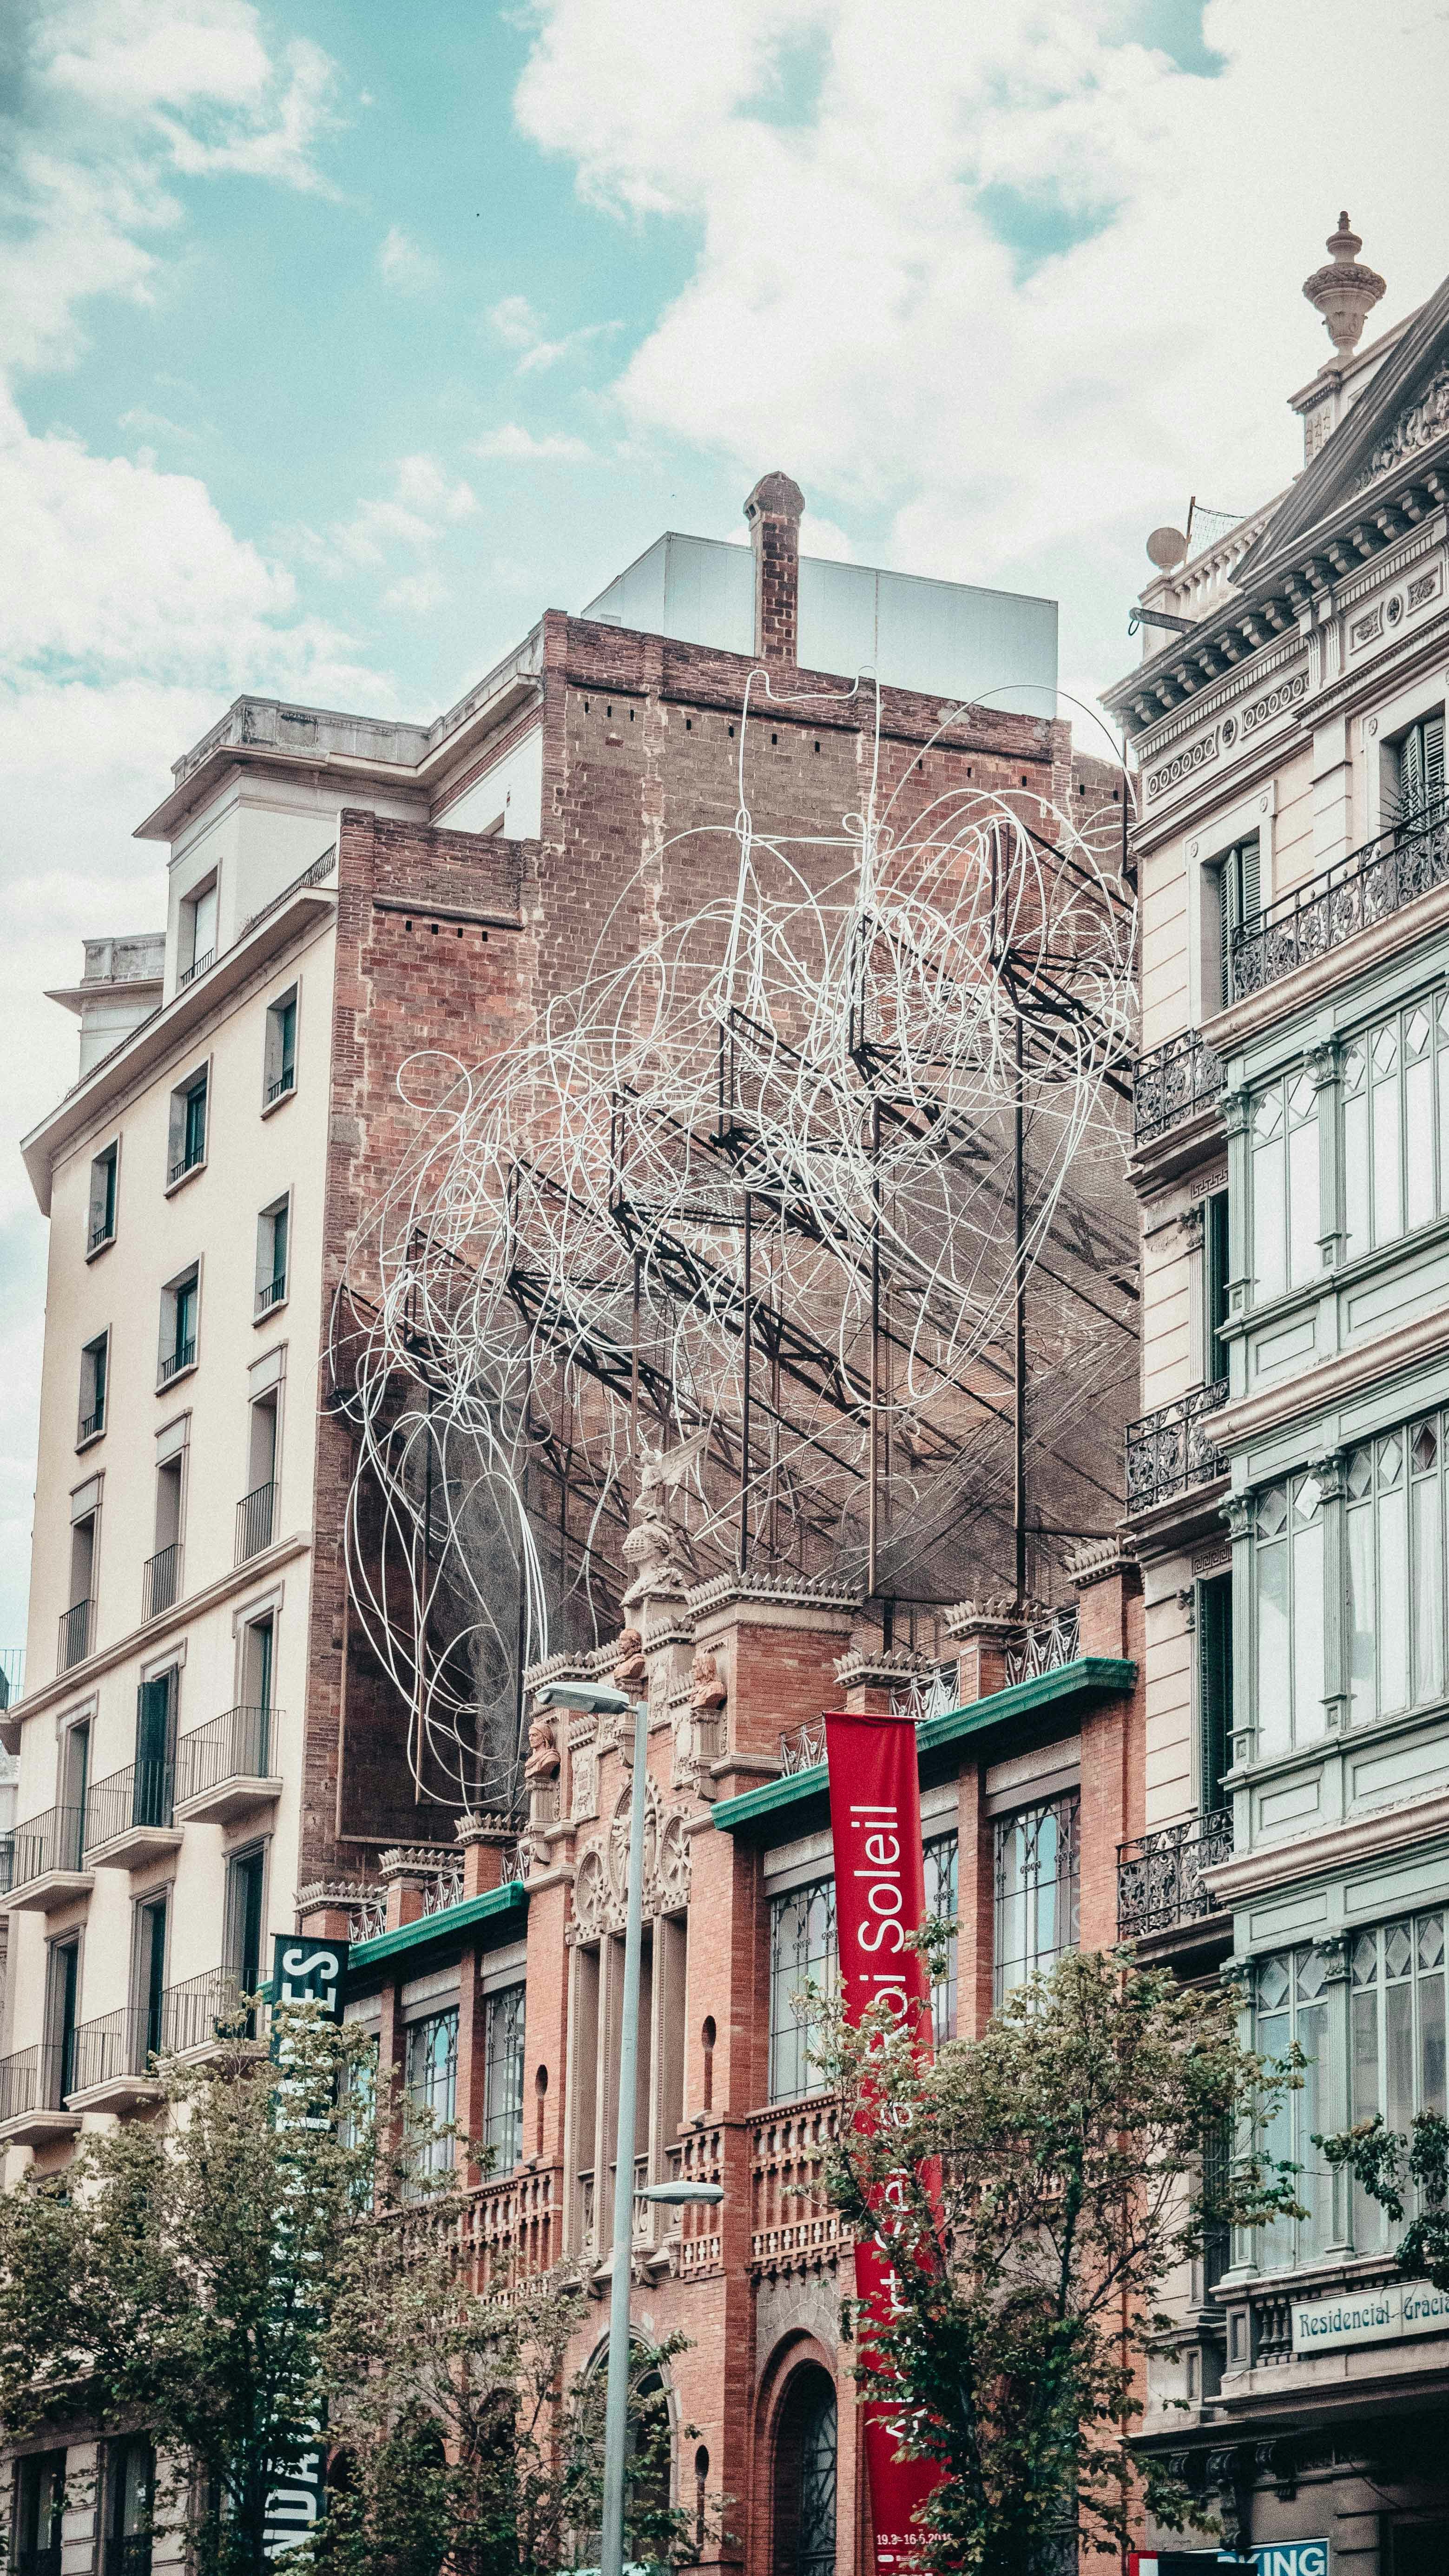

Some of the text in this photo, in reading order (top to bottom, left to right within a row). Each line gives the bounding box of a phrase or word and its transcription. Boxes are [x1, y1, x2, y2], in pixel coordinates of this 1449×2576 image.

[850, 1806, 904, 1953] Soleil
[859, 1975, 909, 2059] Roi
[1299, 2300, 1391, 2338] Residencial
